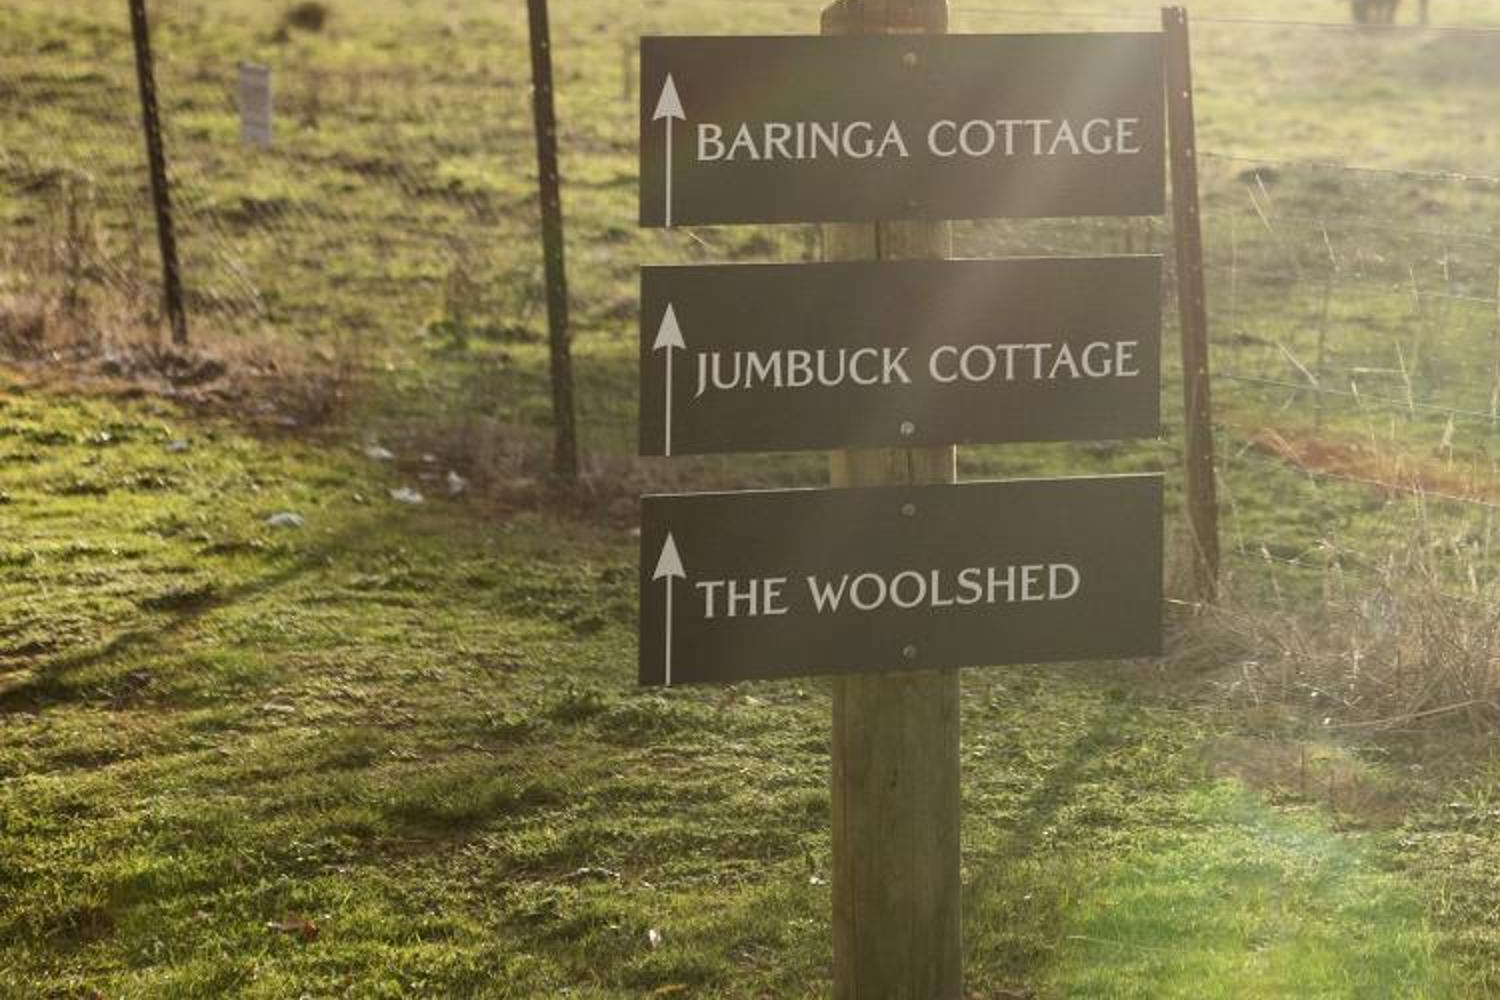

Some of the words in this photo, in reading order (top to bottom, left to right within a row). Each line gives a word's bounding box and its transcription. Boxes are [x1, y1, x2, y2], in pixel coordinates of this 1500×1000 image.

[696, 120, 909, 161] BARINGA
[927, 117, 1140, 157] COTTAGE
[692, 346, 911, 400] JUMBUCK
[928, 341, 1140, 383] COTTAGE
[696, 578, 788, 618] THE
[807, 563, 1080, 611] WOOLSHED
